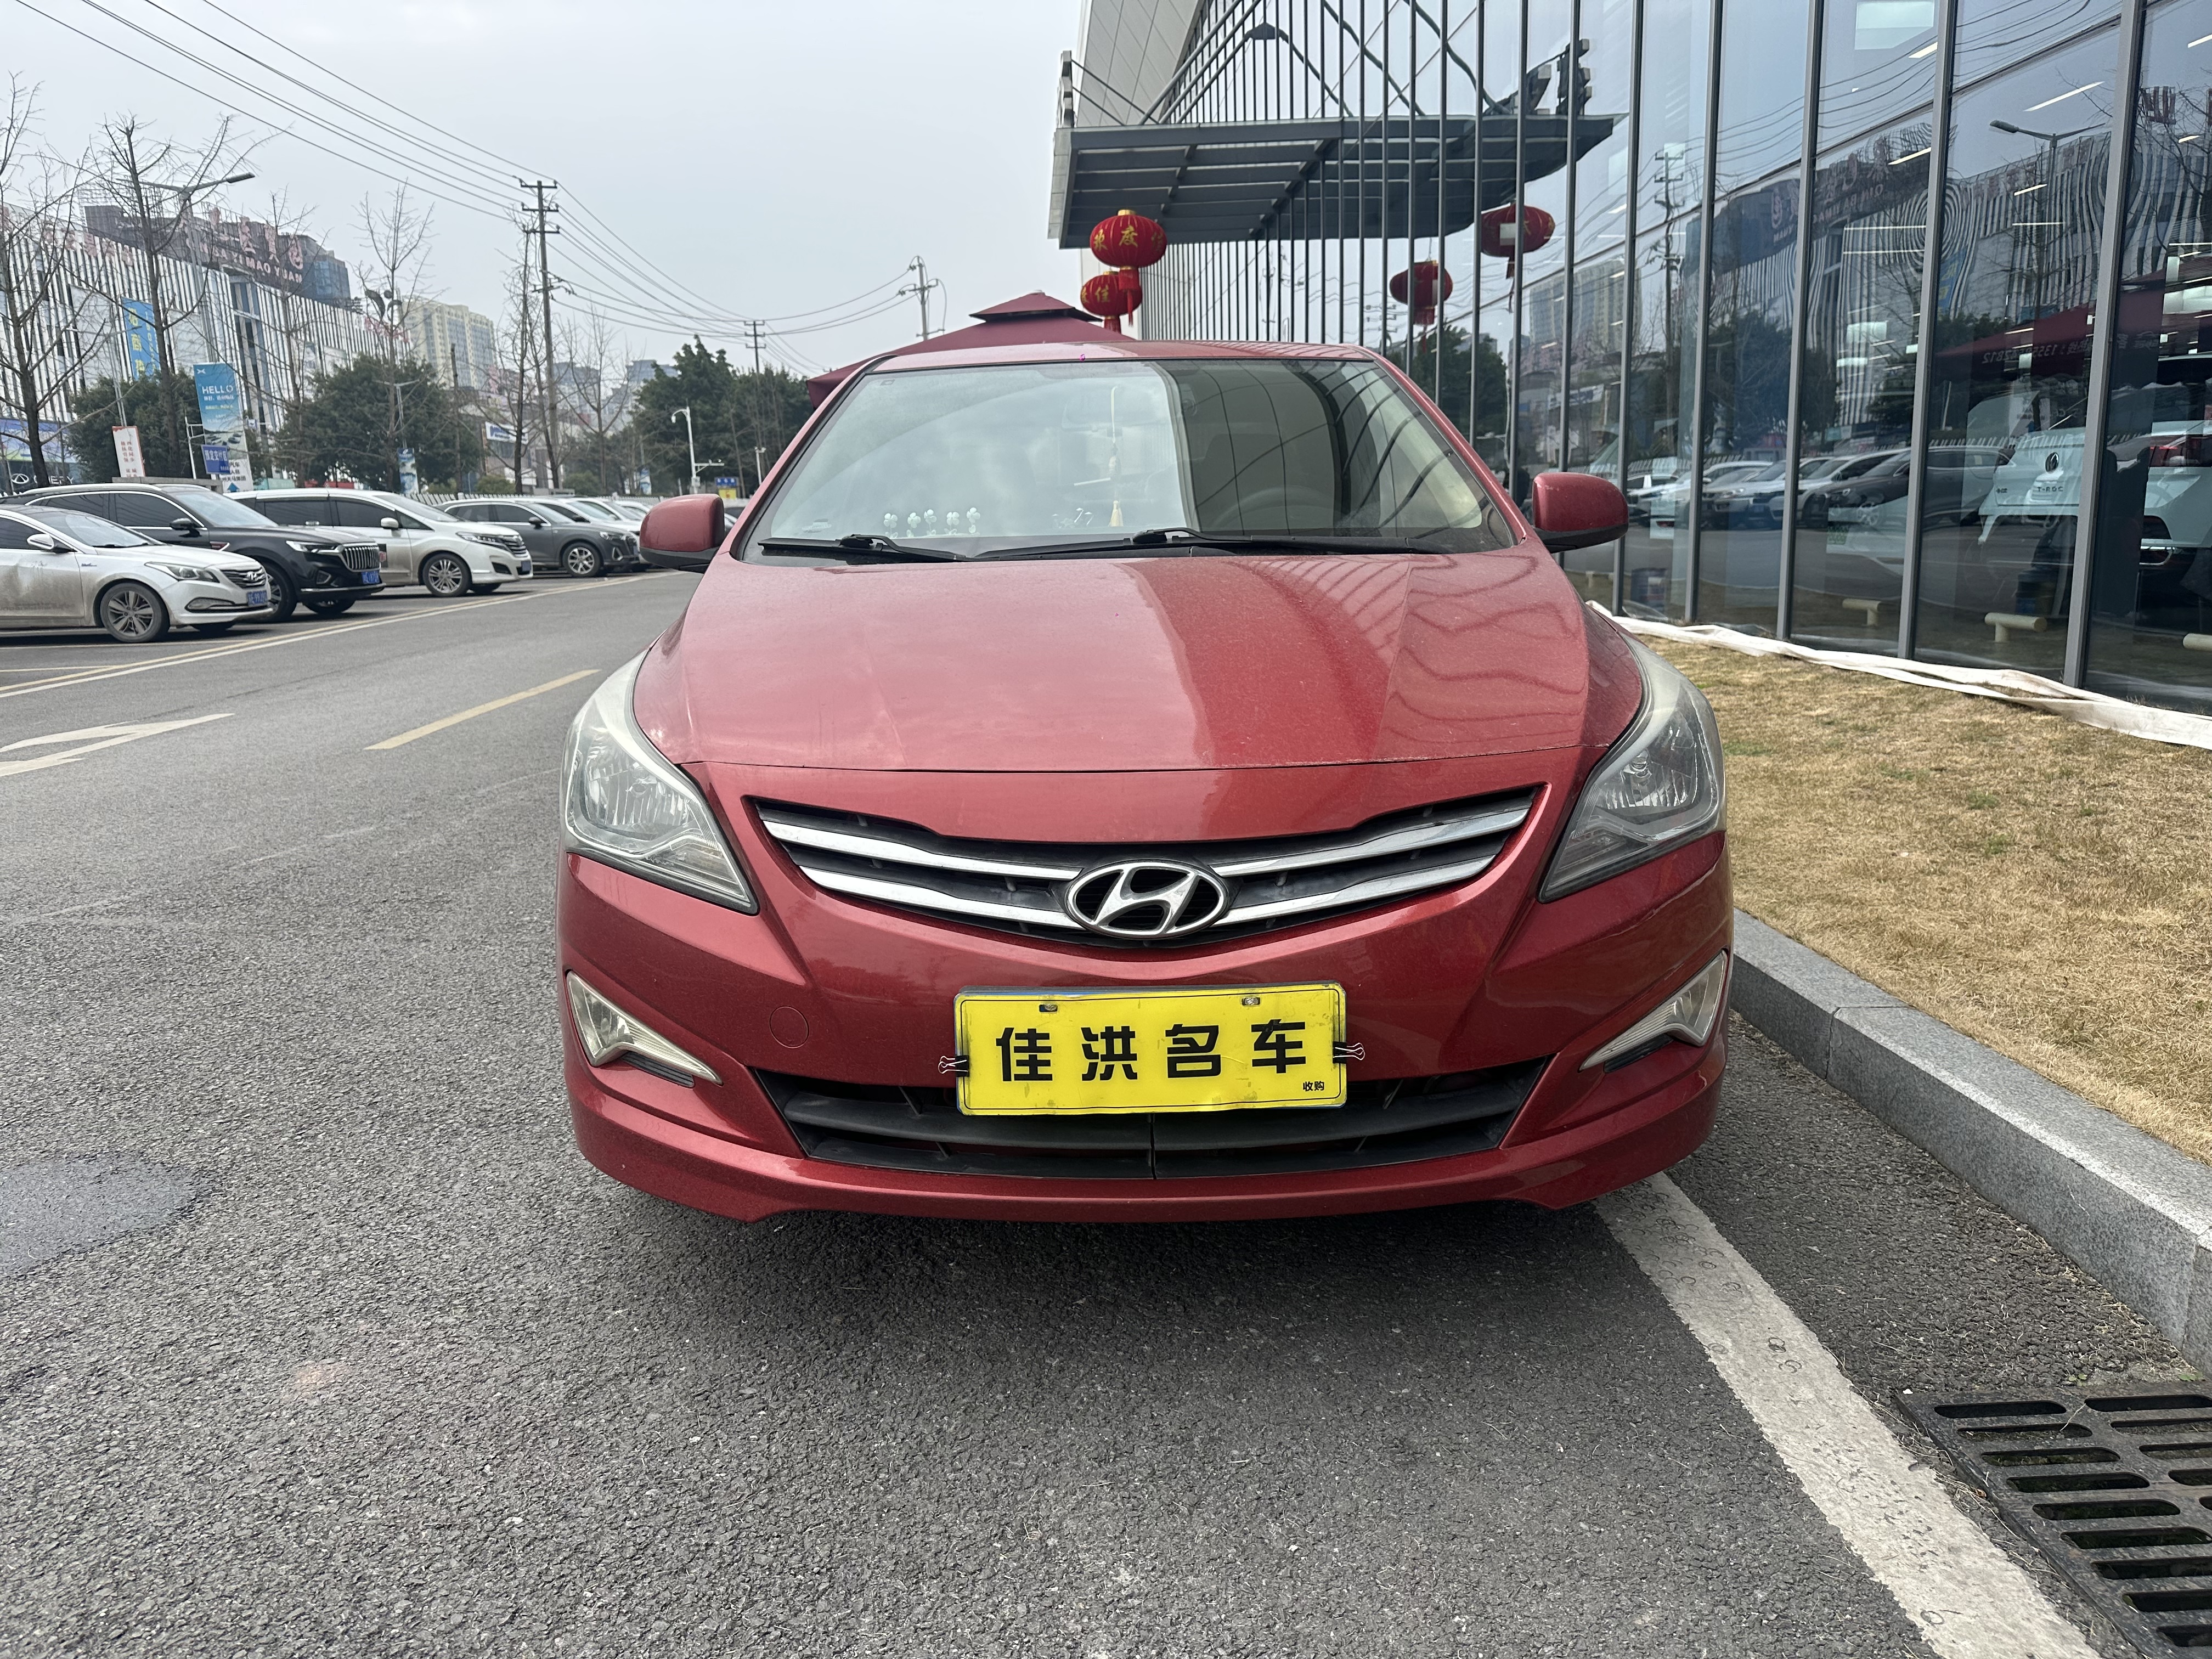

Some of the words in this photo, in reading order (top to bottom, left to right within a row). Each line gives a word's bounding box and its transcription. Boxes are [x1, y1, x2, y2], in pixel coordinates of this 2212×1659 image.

[202, 385, 234, 394] HELLO
[996, 1019, 1306, 1082] 佳洪名车
[1302, 1081, 1325, 1092] 收购
